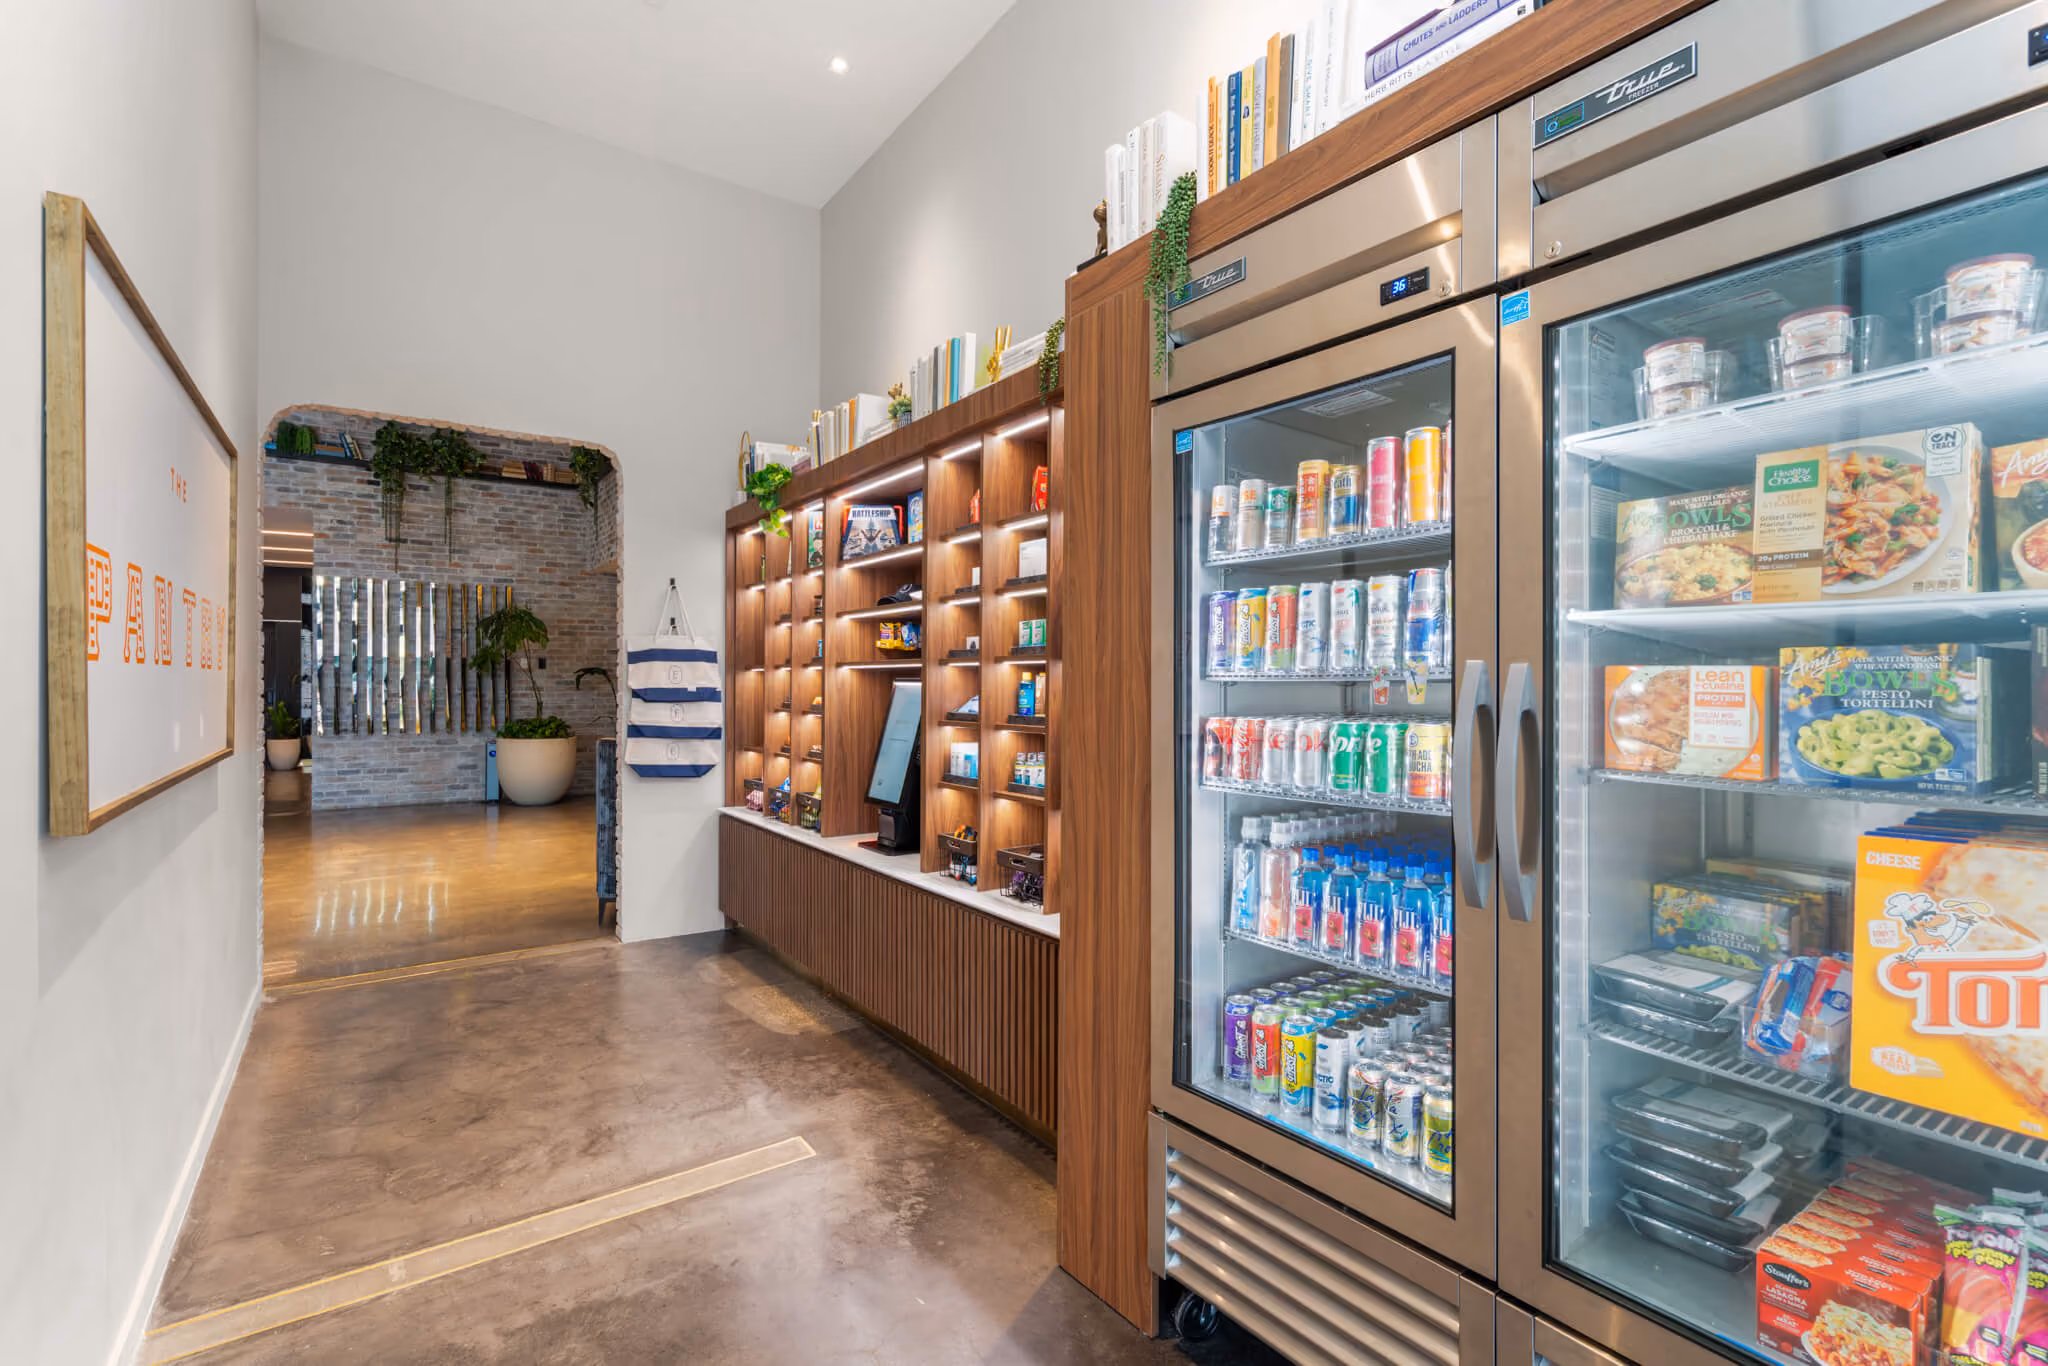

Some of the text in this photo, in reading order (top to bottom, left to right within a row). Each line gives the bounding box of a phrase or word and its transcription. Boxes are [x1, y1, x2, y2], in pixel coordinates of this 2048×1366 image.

[1403, 30, 1433, 52] CHUTES
[1449, 0, 1488, 25] LADDERS
[1389, 70, 1413, 88] RITTS
[1628, 82, 1660, 101] FREEZER
[1391, 278, 1407, 294] 36
[1931, 441, 1957, 450] TRACK
[1768, 475, 1814, 487] Choice
[1773, 466, 1811, 481] Healthy
[170, 466, 188, 504] THE
[1713, 488, 1751, 501] ORGANIC
[852, 508, 892, 518] BATTLESHIP
[1671, 524, 1720, 537] BROCCOLI
[1773, 552, 1809, 561] PROTEIN
[86, 541, 226, 671] PANTRY
[1848, 654, 1953, 664] MADE WITH ORGANIC
[1854, 662, 1889, 670] WHEAT
[1892, 662, 1913, 670] AND
[1785, 649, 1844, 685] Amy's
[1696, 671, 1745, 683] Lean
[1822, 670, 1957, 697] BOWLS
[1862, 689, 1911, 699] PESTO
[1840, 698, 1934, 710] TORTELLINI
[1865, 851, 1922, 871] CHEESE
[1711, 928, 1745, 941] PESTO
[1696, 932, 1761, 953] TORTELLINI
[1764, 1263, 1810, 1288] Stouffer's
[1765, 1284, 1808, 1306] LASAGNA
